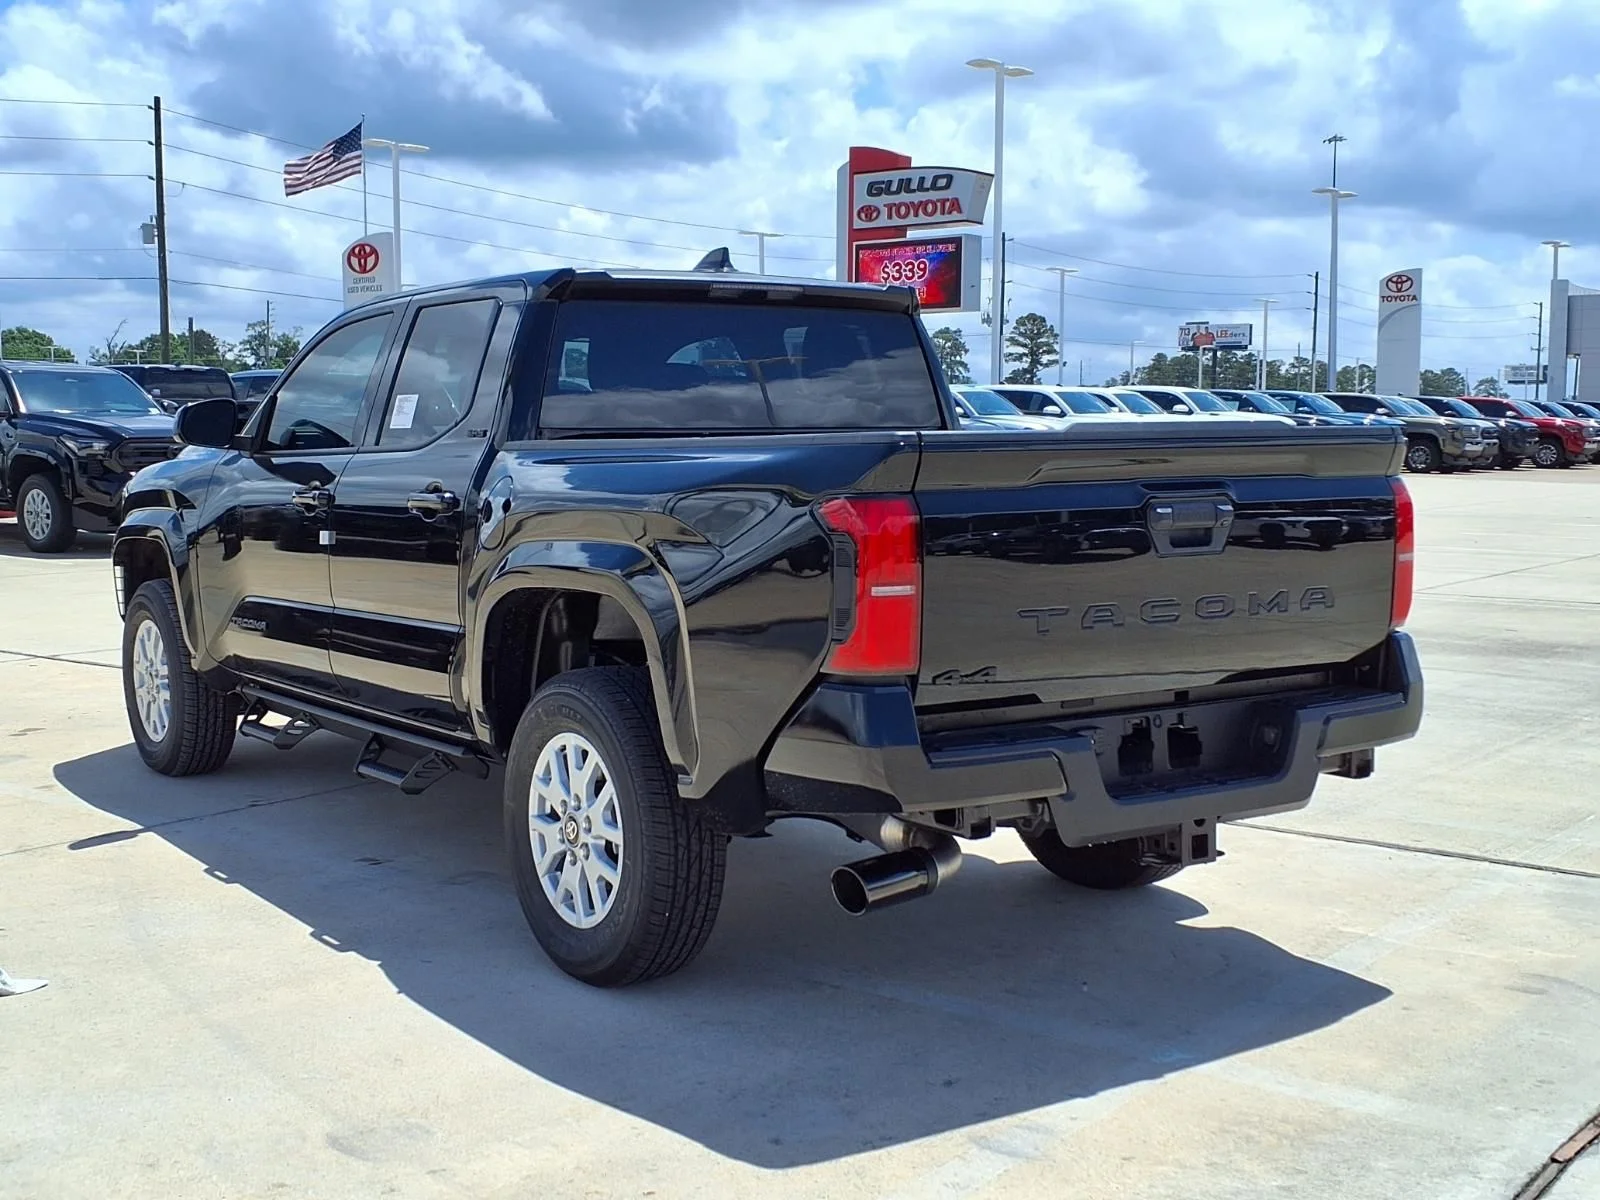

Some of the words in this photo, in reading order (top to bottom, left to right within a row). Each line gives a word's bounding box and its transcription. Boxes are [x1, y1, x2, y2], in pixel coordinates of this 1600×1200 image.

[866, 173, 953, 197] GULLO
[884, 197, 963, 220] TOYOTA
[353, 276, 376, 285] CERTIFIED
[881, 259, 929, 282] $339
[360, 285, 383, 293] VEHICLES
[1017, 585, 1336, 635] TACOMA
[231, 616, 267, 631] TACOMA
